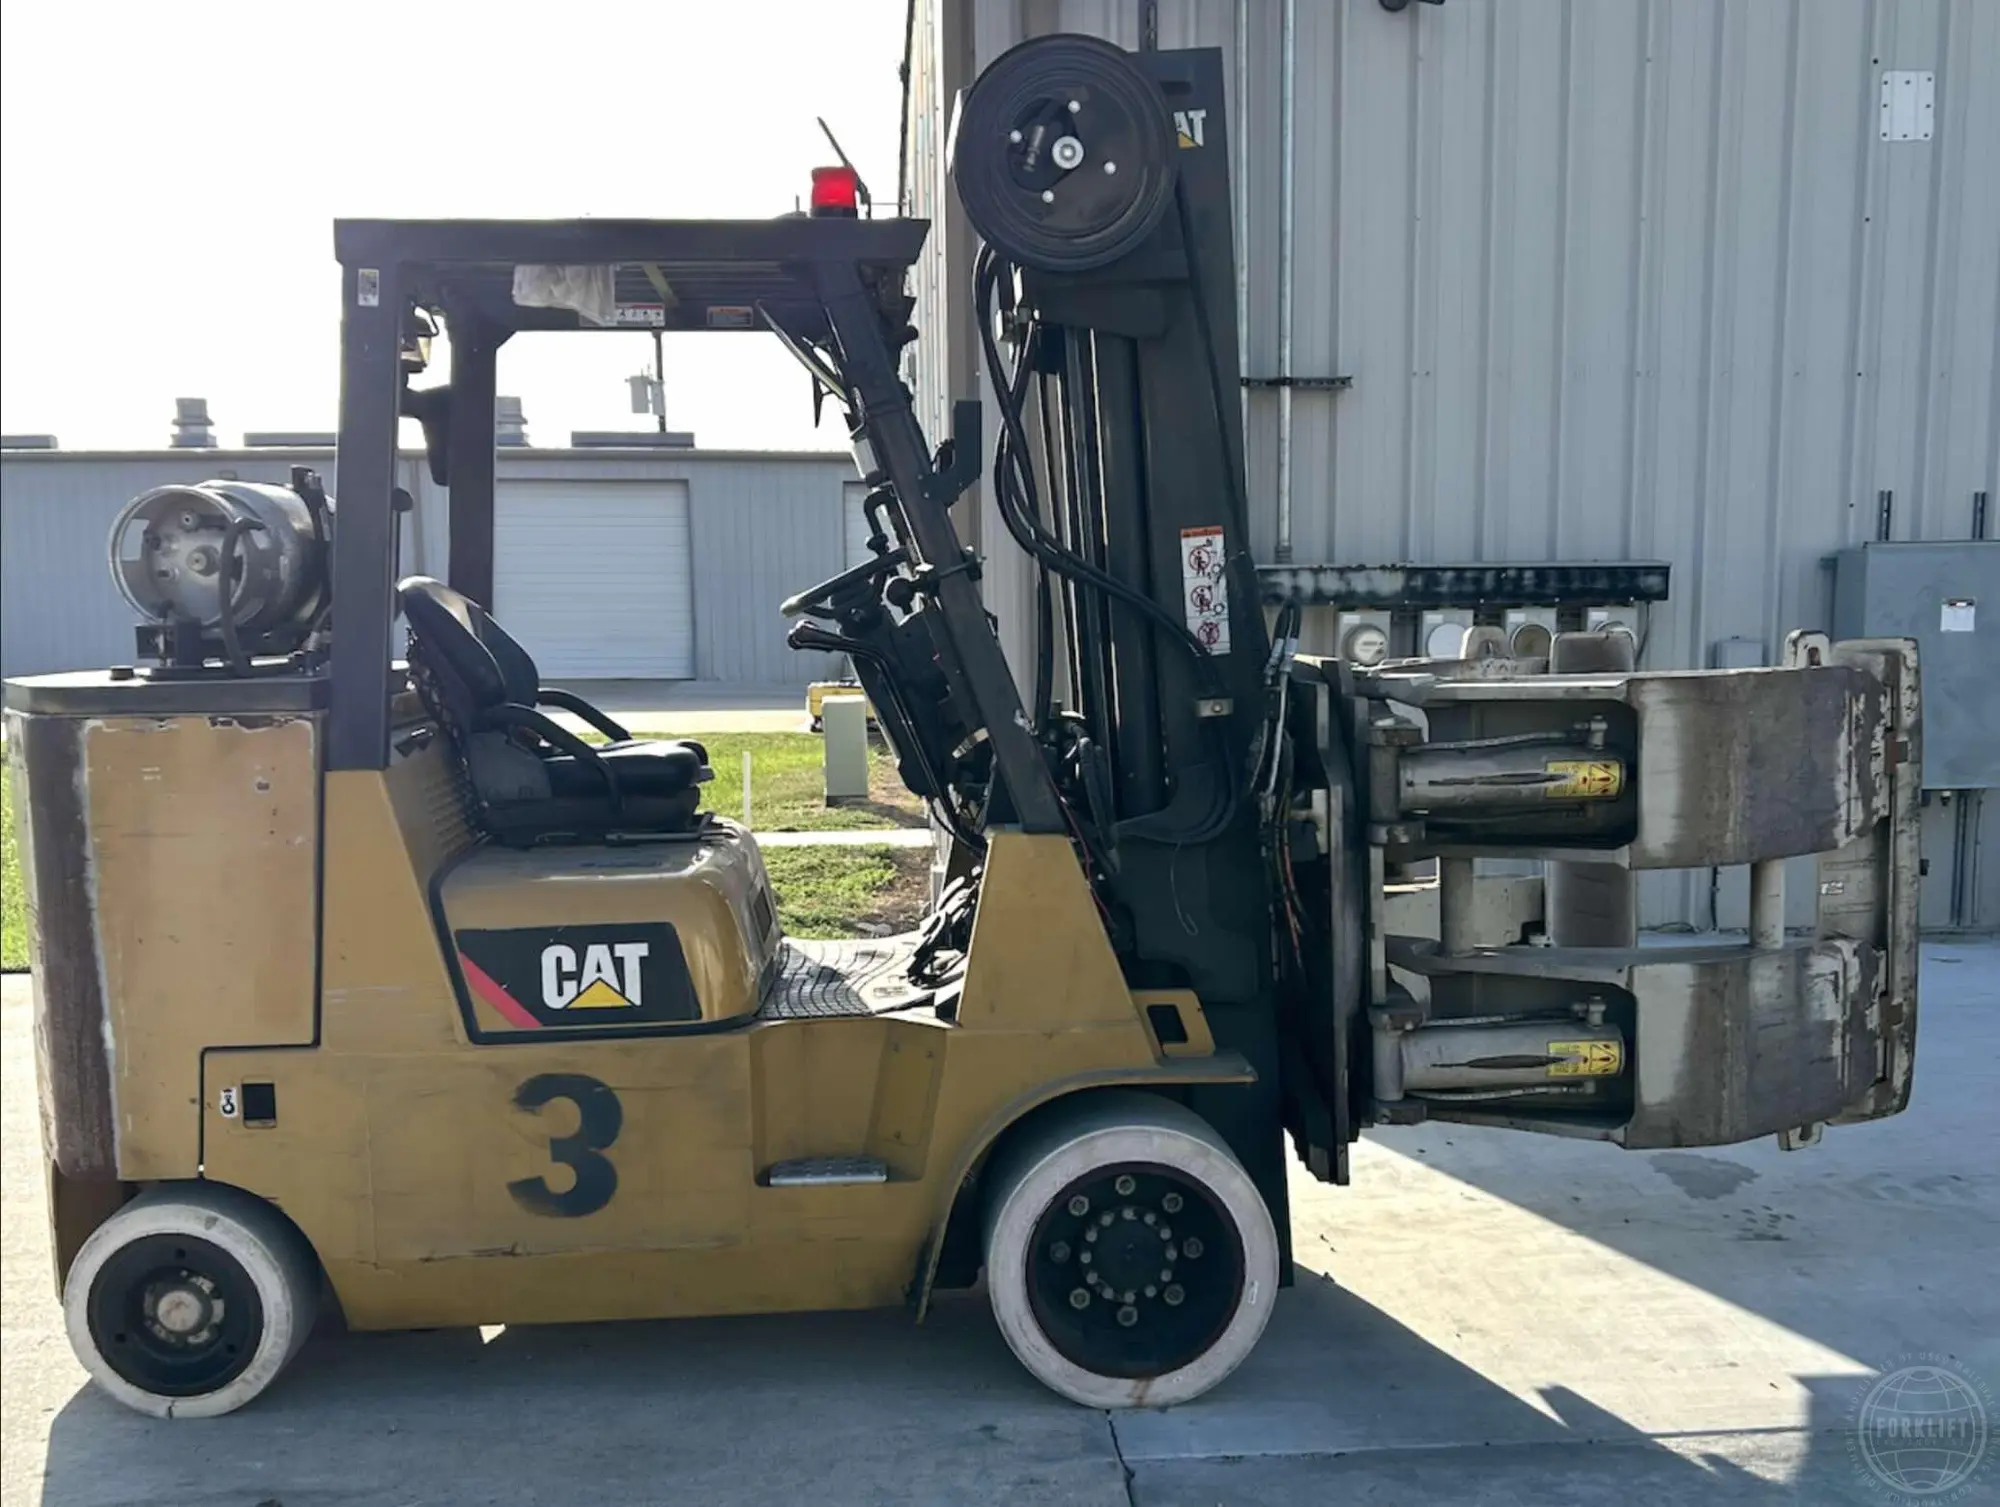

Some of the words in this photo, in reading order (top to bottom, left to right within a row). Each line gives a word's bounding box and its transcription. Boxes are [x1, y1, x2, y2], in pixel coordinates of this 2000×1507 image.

[1173, 109, 1206, 148] AT
[541, 942, 649, 1010] CAT
[506, 1072, 624, 1219] 3
